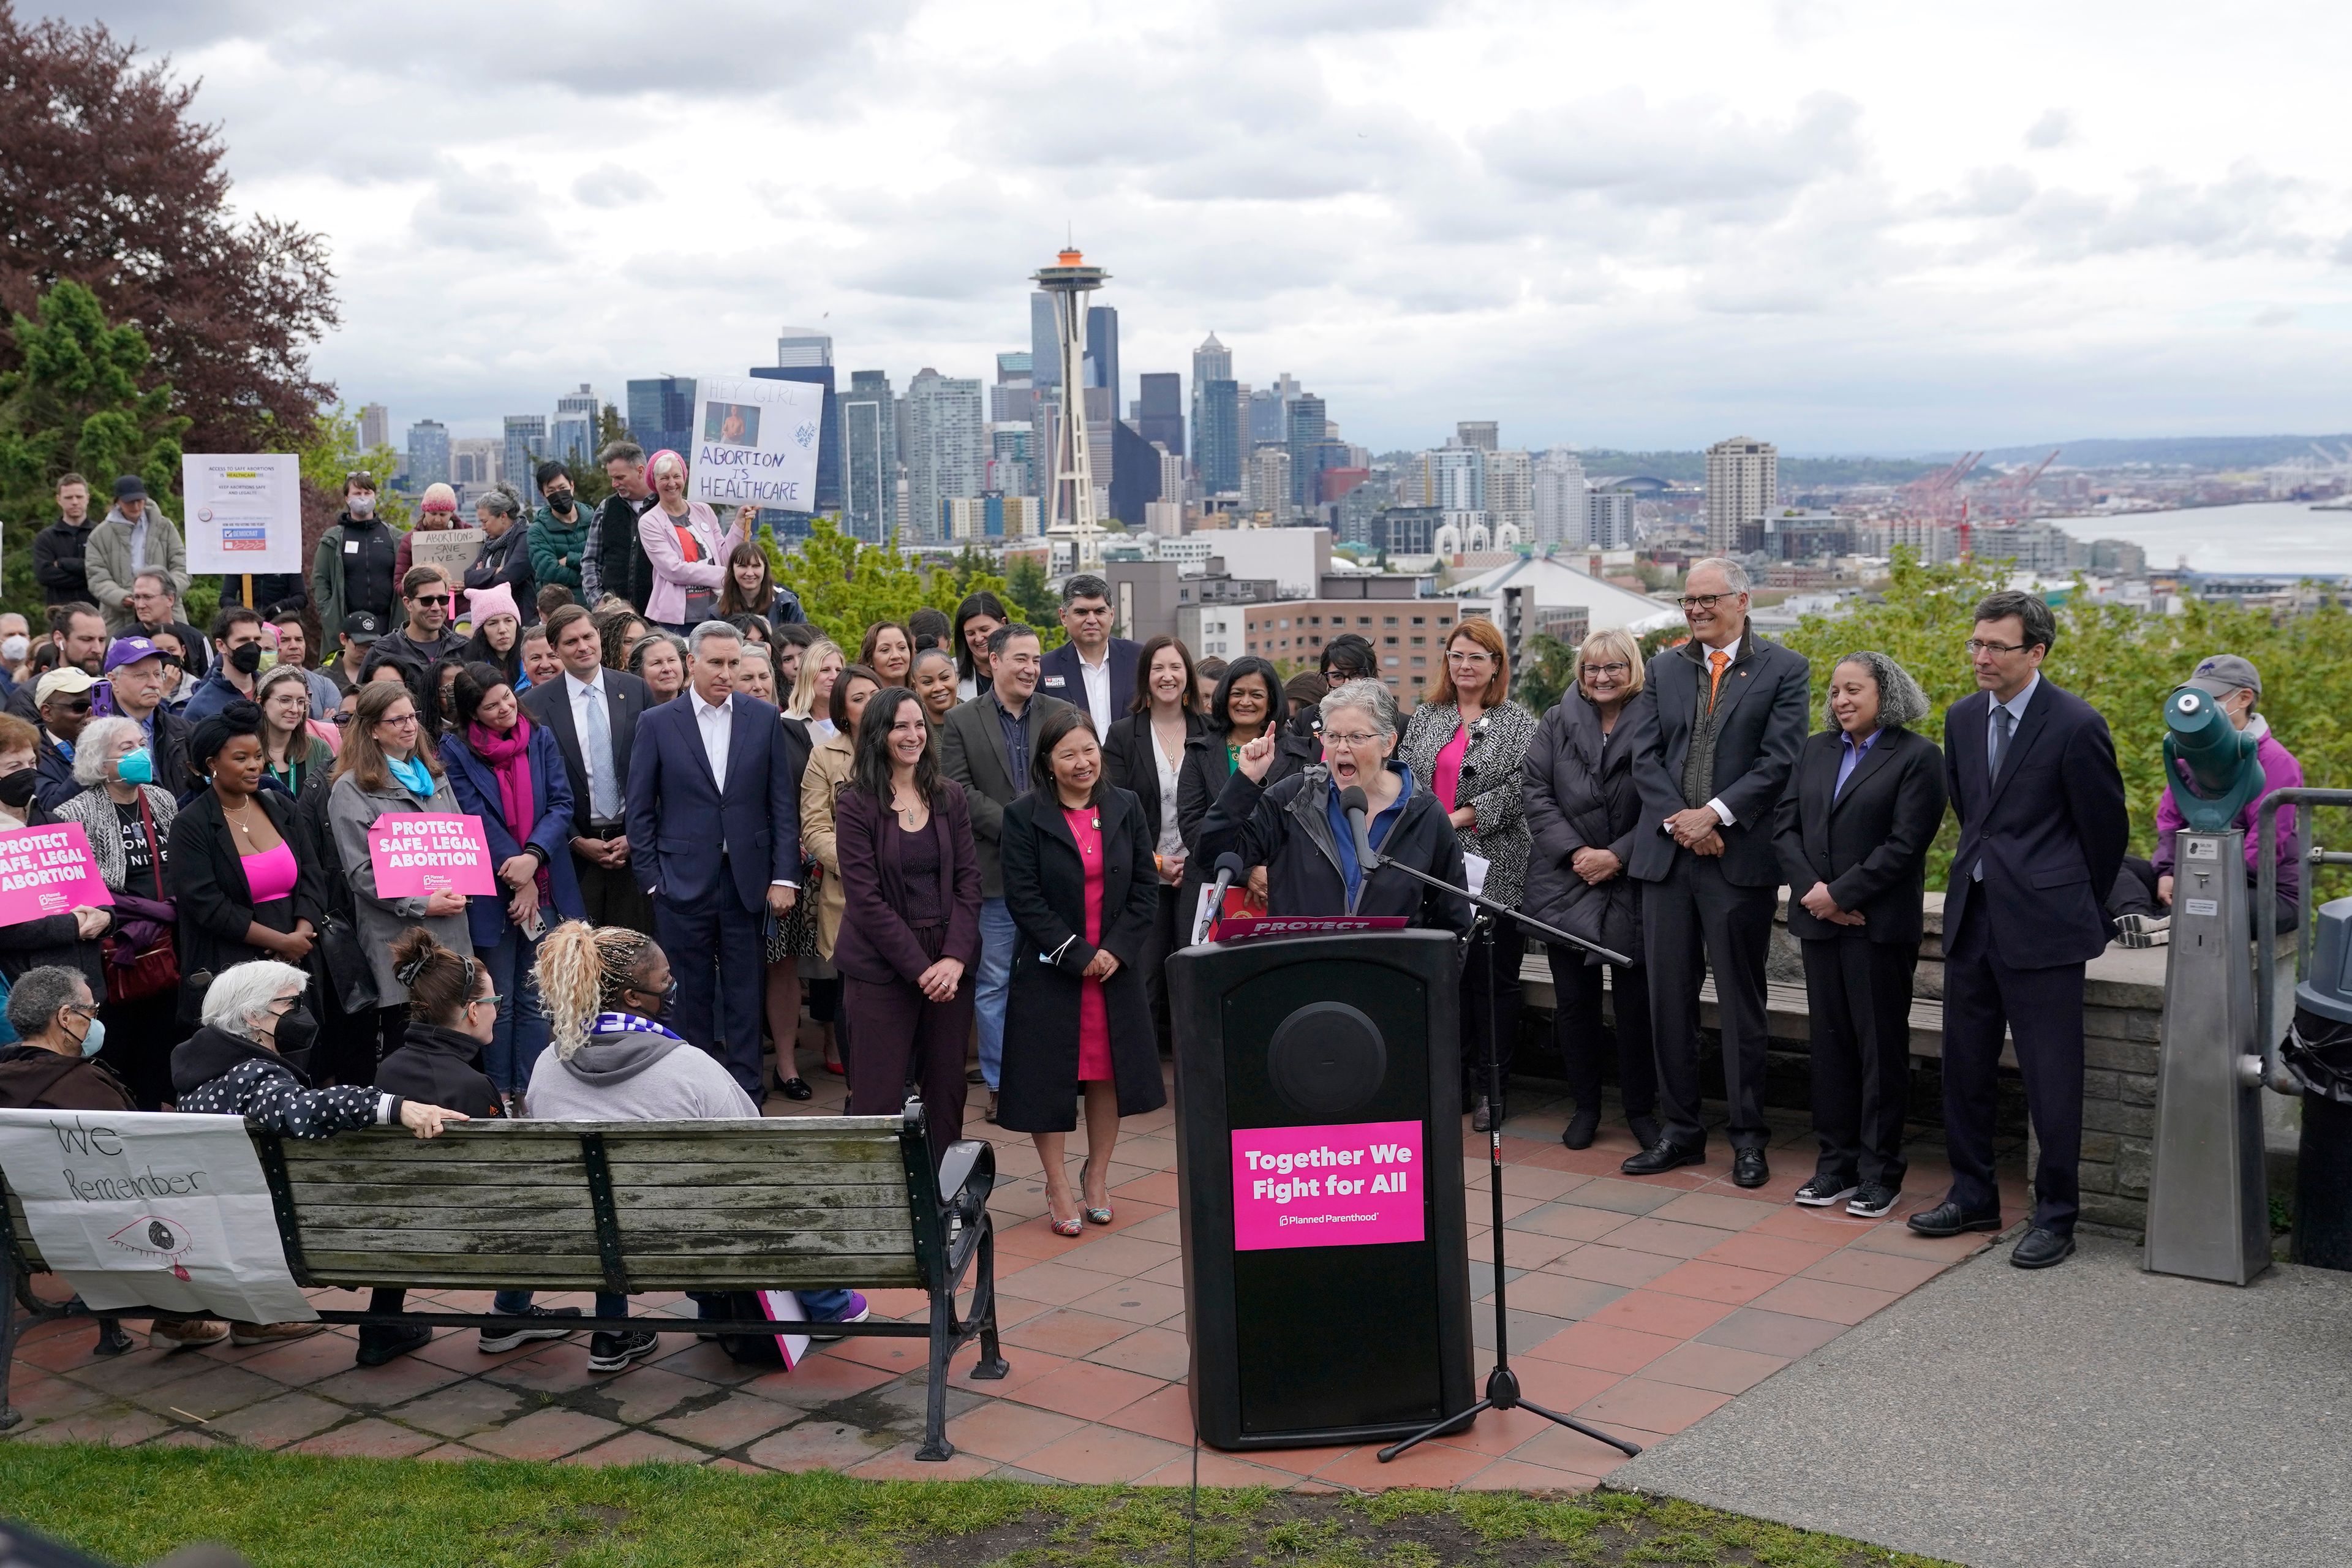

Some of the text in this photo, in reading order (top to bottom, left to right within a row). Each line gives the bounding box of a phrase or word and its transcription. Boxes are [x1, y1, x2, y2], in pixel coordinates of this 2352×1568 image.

[710, 378, 797, 405] HEY GIRL
[699, 446, 785, 467] ABORTION
[732, 469, 750, 480] IS
[701, 477, 799, 502] HEALTHCARE
[426, 532, 473, 543] ABORTIONS
[434, 545, 460, 554] SAVE
[391, 821, 464, 835] PROTECT
[0, 832, 69, 856] PROTECT
[379, 836, 481, 853] SAFE, LEGAL
[0, 848, 87, 875] AFE, LEGAL
[390, 851, 478, 868] ABORTION
[2, 865, 86, 892] ABORTION
[1254, 922, 1370, 932] PROTECT
[50, 1115, 123, 1156] We
[1245, 1144, 1412, 1174] Together We
[63, 1165, 207, 1203] Remember
[1253, 1172, 1407, 1204] Fight for All
[1289, 1213, 1377, 1224] Planned Parenthood
